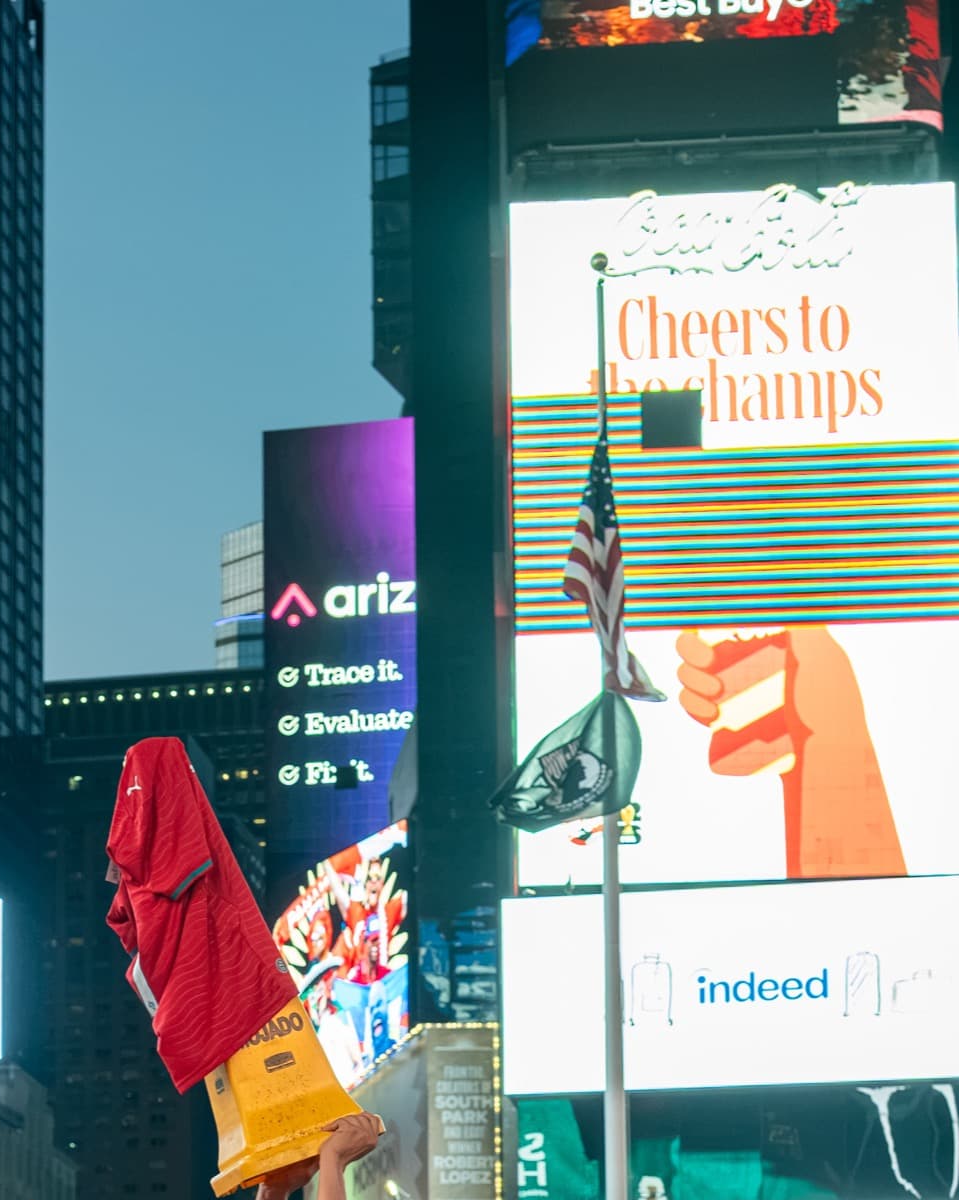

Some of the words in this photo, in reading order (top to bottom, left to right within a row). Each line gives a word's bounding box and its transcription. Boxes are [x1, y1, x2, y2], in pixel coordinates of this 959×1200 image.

[617, 296, 788, 360] Cheers
[799, 296, 851, 353] to
[323, 571, 417, 618] ariz
[304, 663, 375, 686] Trace
[376, 659, 403, 683] it.
[304, 708, 414, 735] Evaluate
[697, 969, 828, 1004] indeed
[240, 1011, 304, 1049] OJADO
[441, 1109, 488, 1124] PARK
[439, 1169, 492, 1185] LOPEZ
